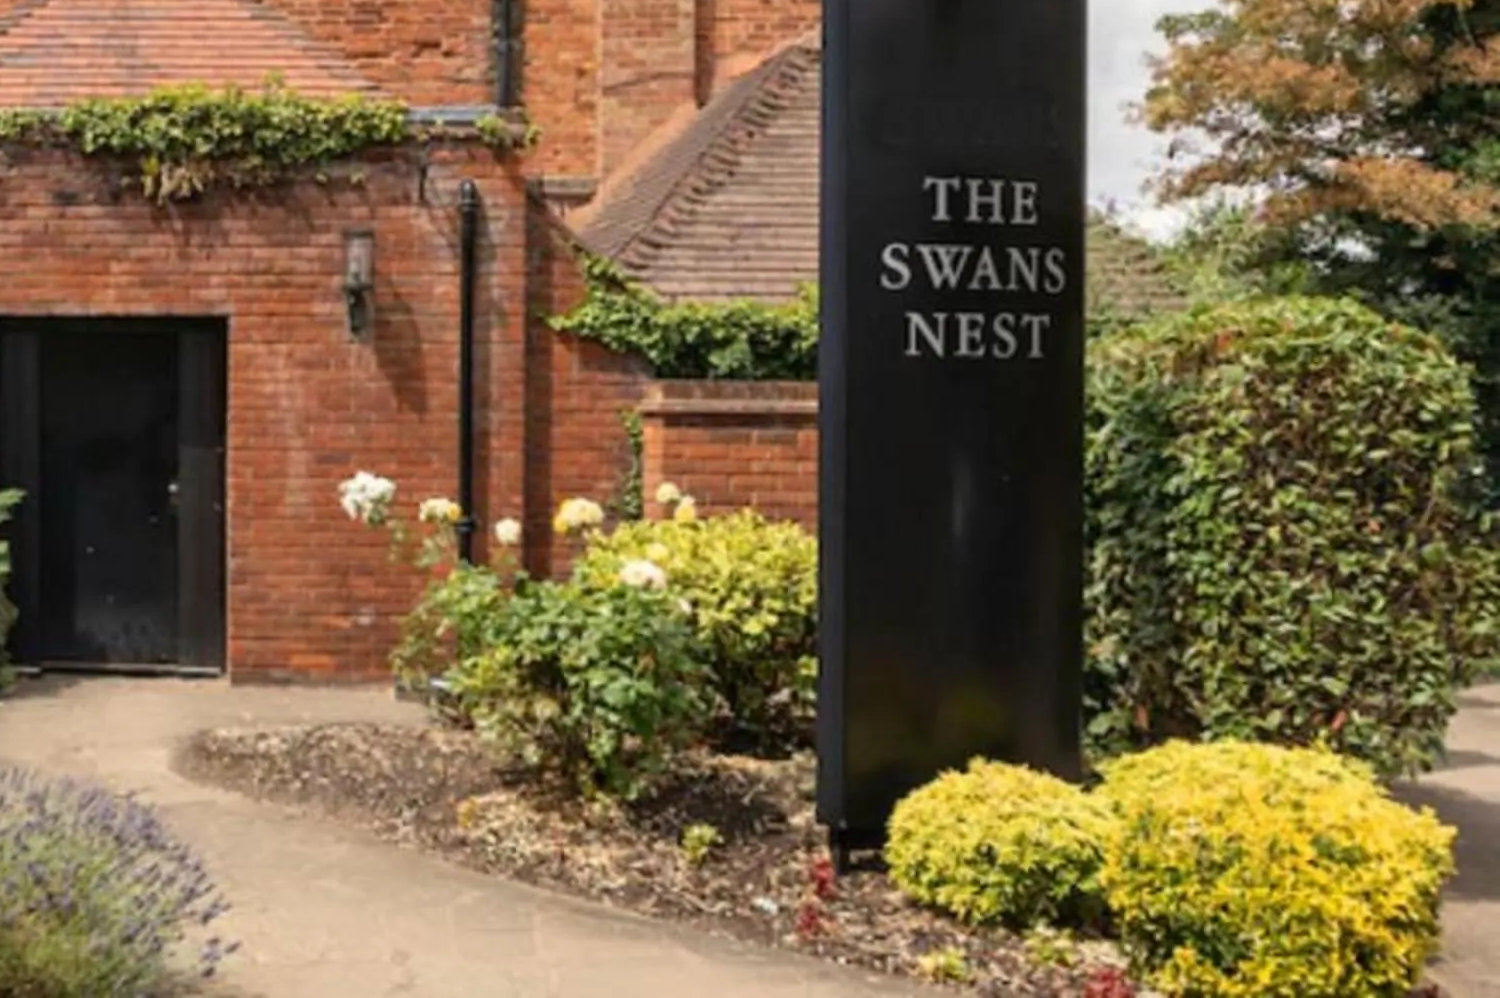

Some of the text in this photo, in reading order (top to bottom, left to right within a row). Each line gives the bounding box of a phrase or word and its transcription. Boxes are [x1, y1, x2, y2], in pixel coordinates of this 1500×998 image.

[923, 176, 1038, 225] THE
[880, 242, 1066, 294] SWANS
[905, 311, 1051, 358] NEST
